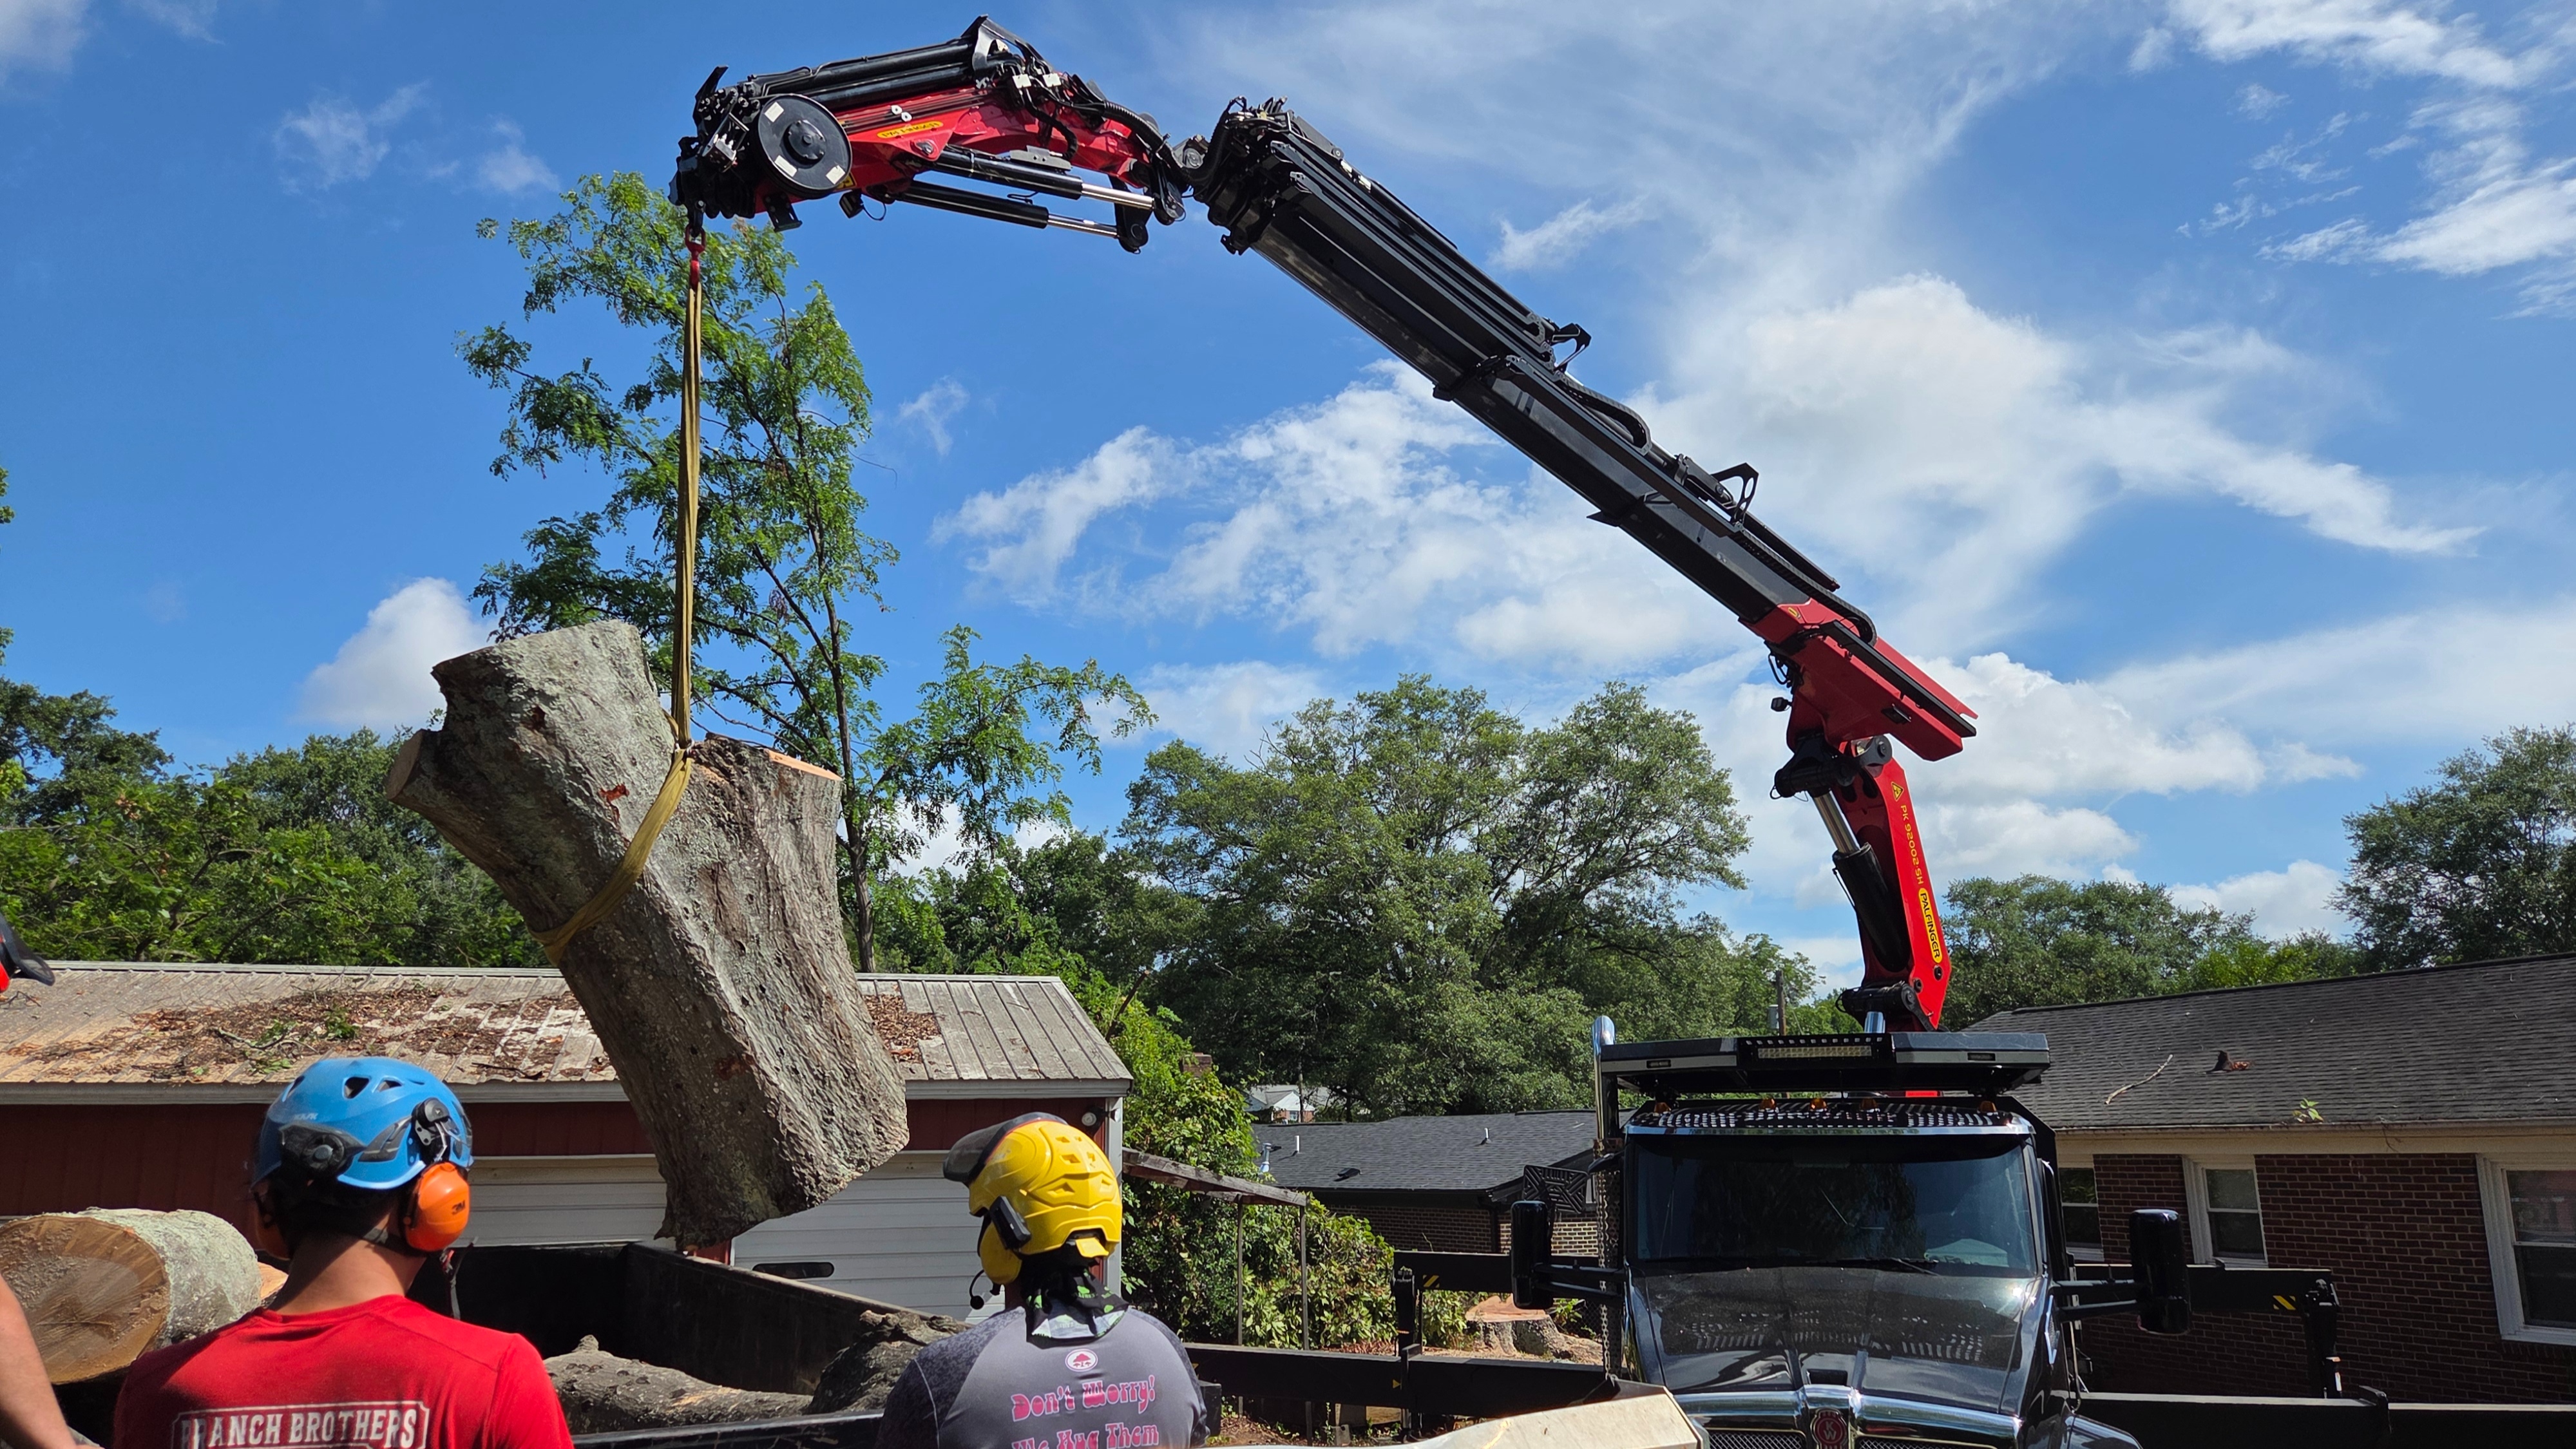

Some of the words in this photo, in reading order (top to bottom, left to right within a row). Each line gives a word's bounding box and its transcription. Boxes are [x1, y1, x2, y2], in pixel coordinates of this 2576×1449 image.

[1901, 804, 1909, 821] PK
[1920, 892, 1940, 958] PALFINGER
[452, 1200, 465, 1215] 3M
[1011, 1385, 1075, 1421] Don't
[1082, 1375, 1155, 1414] Worry!
[289, 1409, 417, 1449] BROTHERS
[1105, 1422, 1159, 1449] Them
